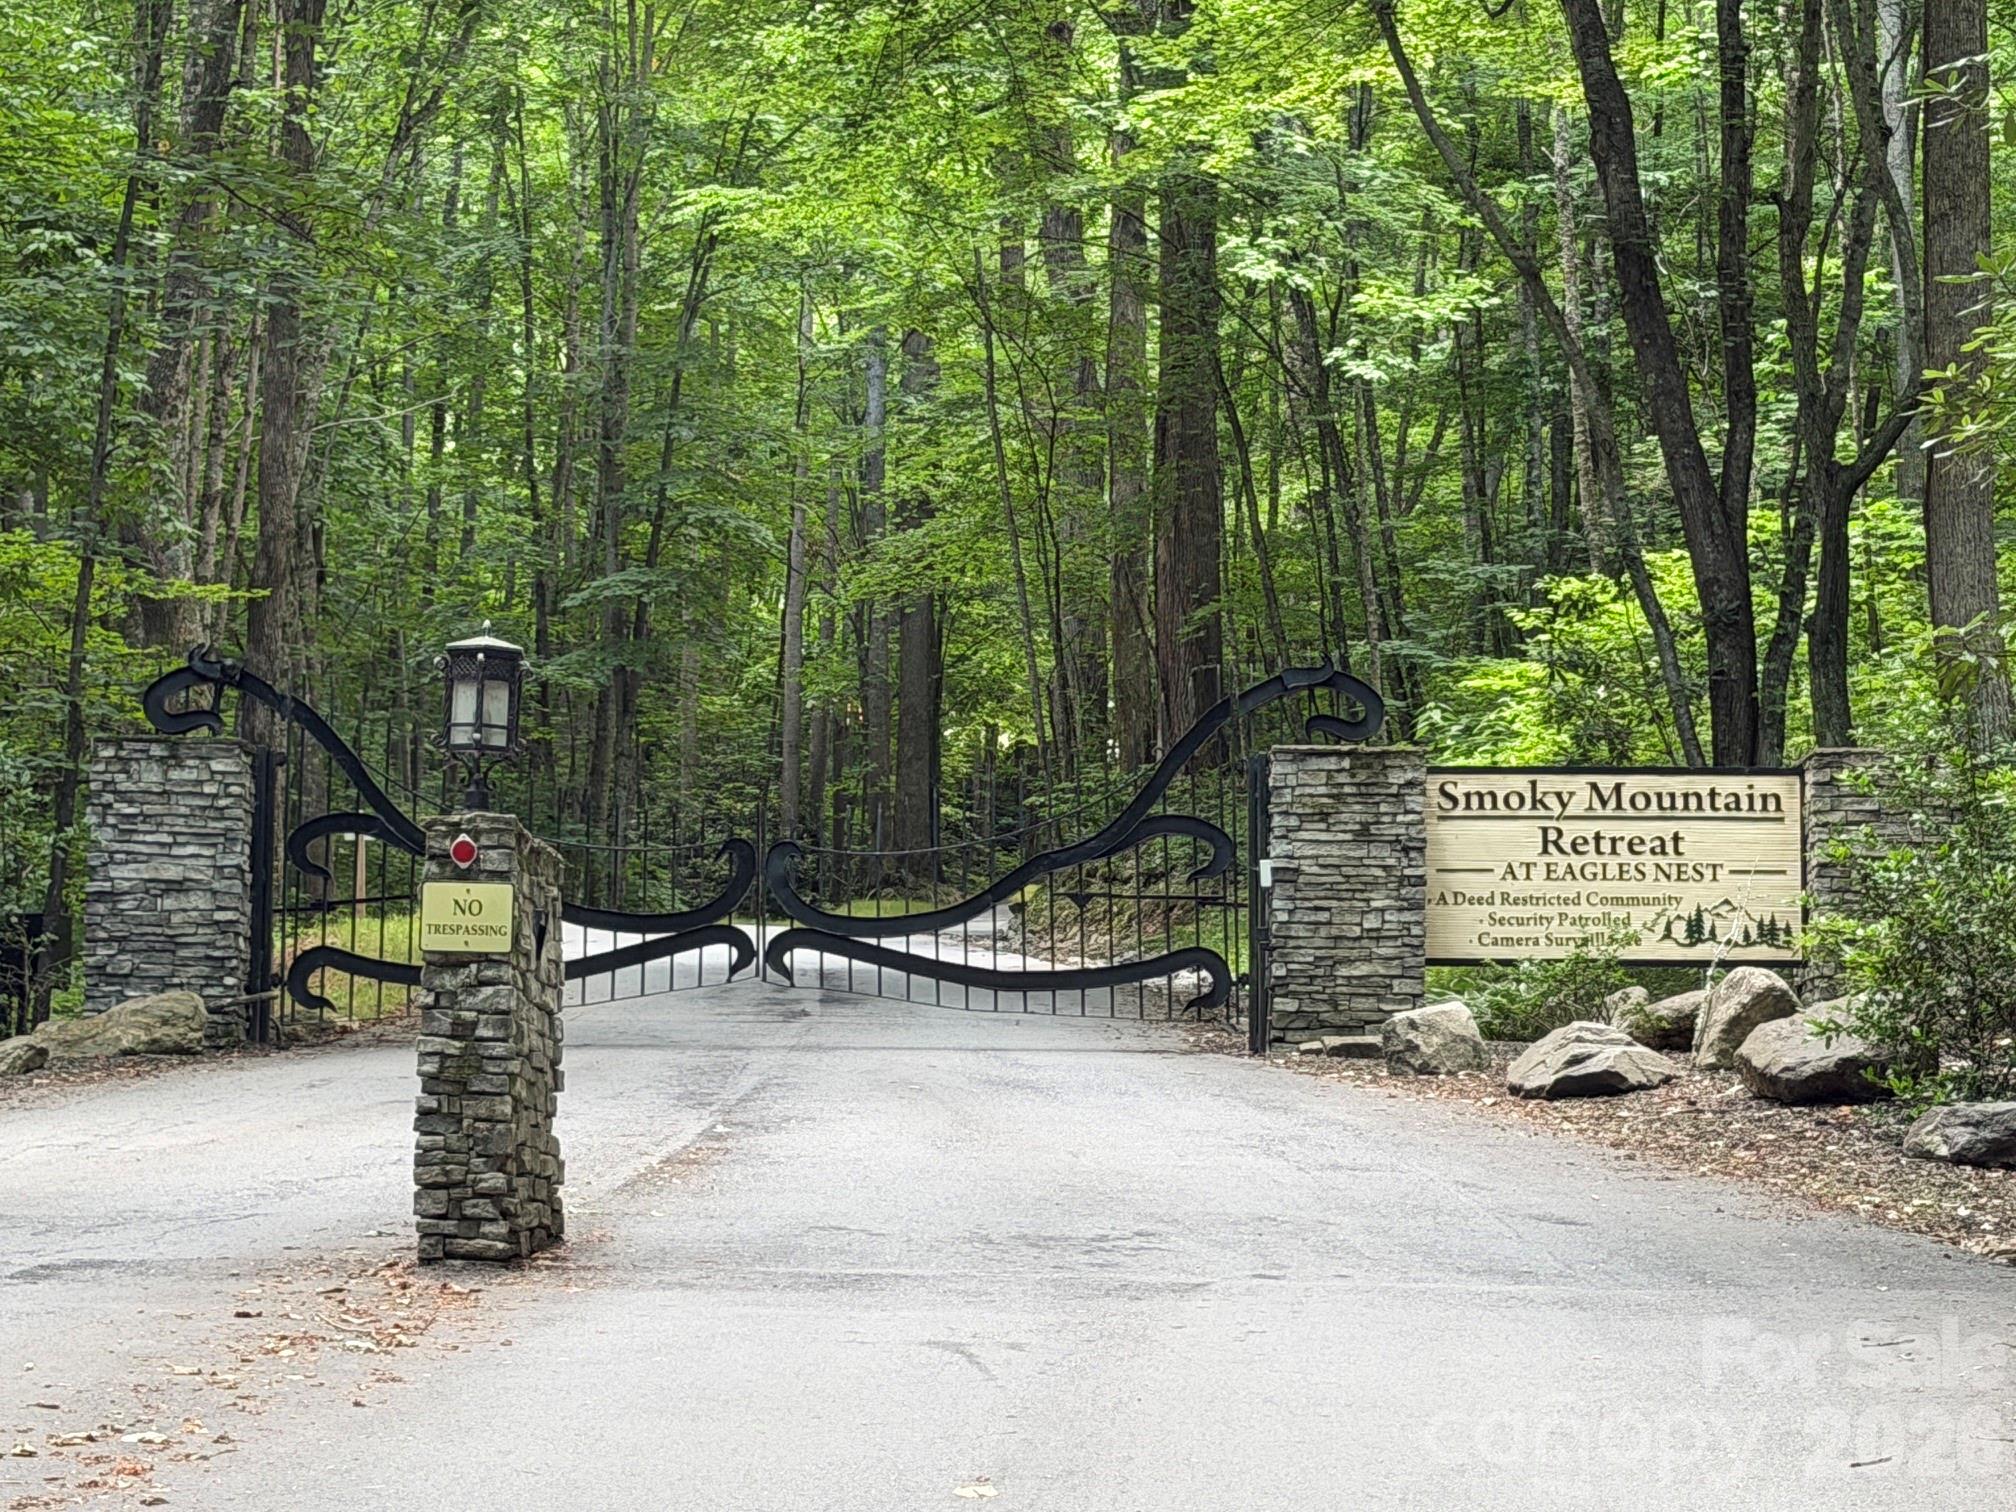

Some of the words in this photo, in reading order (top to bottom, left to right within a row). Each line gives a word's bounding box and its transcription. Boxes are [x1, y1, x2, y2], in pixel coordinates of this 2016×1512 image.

[1437, 780, 1576, 821] Smoky
[1585, 780, 1784, 813] Mountain
[1538, 826, 1685, 856] Retreat
[1499, 862, 1537, 881] AT
[1543, 862, 1646, 882] EAGLES
[1654, 862, 1724, 882] NEST
[452, 898, 483, 917] NO
[1435, 891, 1449, 906] A
[1452, 891, 1495, 906] Deed
[1500, 891, 1582, 907] Restricted
[1586, 891, 1683, 910] Community
[426, 923, 508, 937] TRESPASSING
[1487, 912, 1554, 930] Security
[1557, 911, 1632, 928] Patrolled
[1477, 932, 1540, 947] Camera
